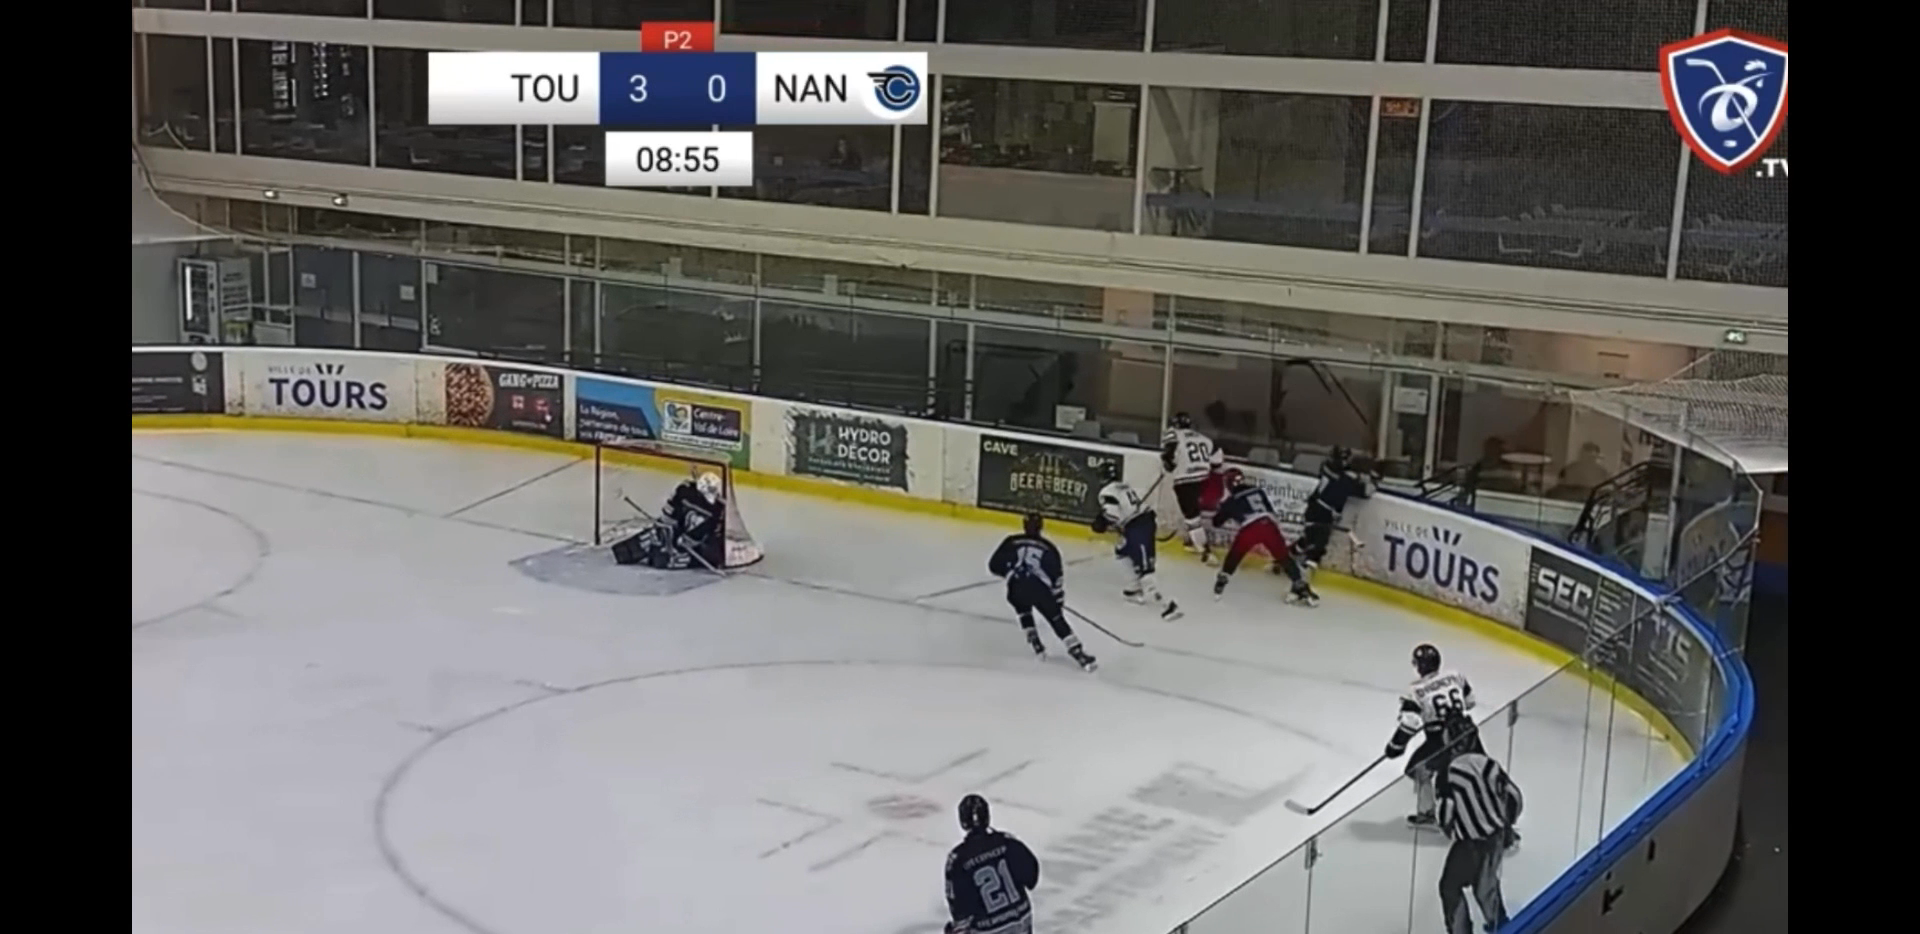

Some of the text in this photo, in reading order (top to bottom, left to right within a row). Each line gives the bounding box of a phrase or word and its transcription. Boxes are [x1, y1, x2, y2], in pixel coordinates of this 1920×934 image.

[268, 377, 388, 411] TOURS
[498, 373, 559, 389] GANG PIZZA
[838, 426, 892, 445] HYDRO
[983, 440, 1019, 456] CAVE
[1186, 441, 1209, 463] 20
[1010, 472, 1043, 491] BEER
[1053, 476, 1088, 502] BEER?
[1384, 519, 1412, 534] VILLE
[1383, 534, 1499, 604] TOURS
[1537, 566, 1593, 619] SEC
[1432, 688, 1463, 719] 66
[973, 858, 1020, 913] 21
